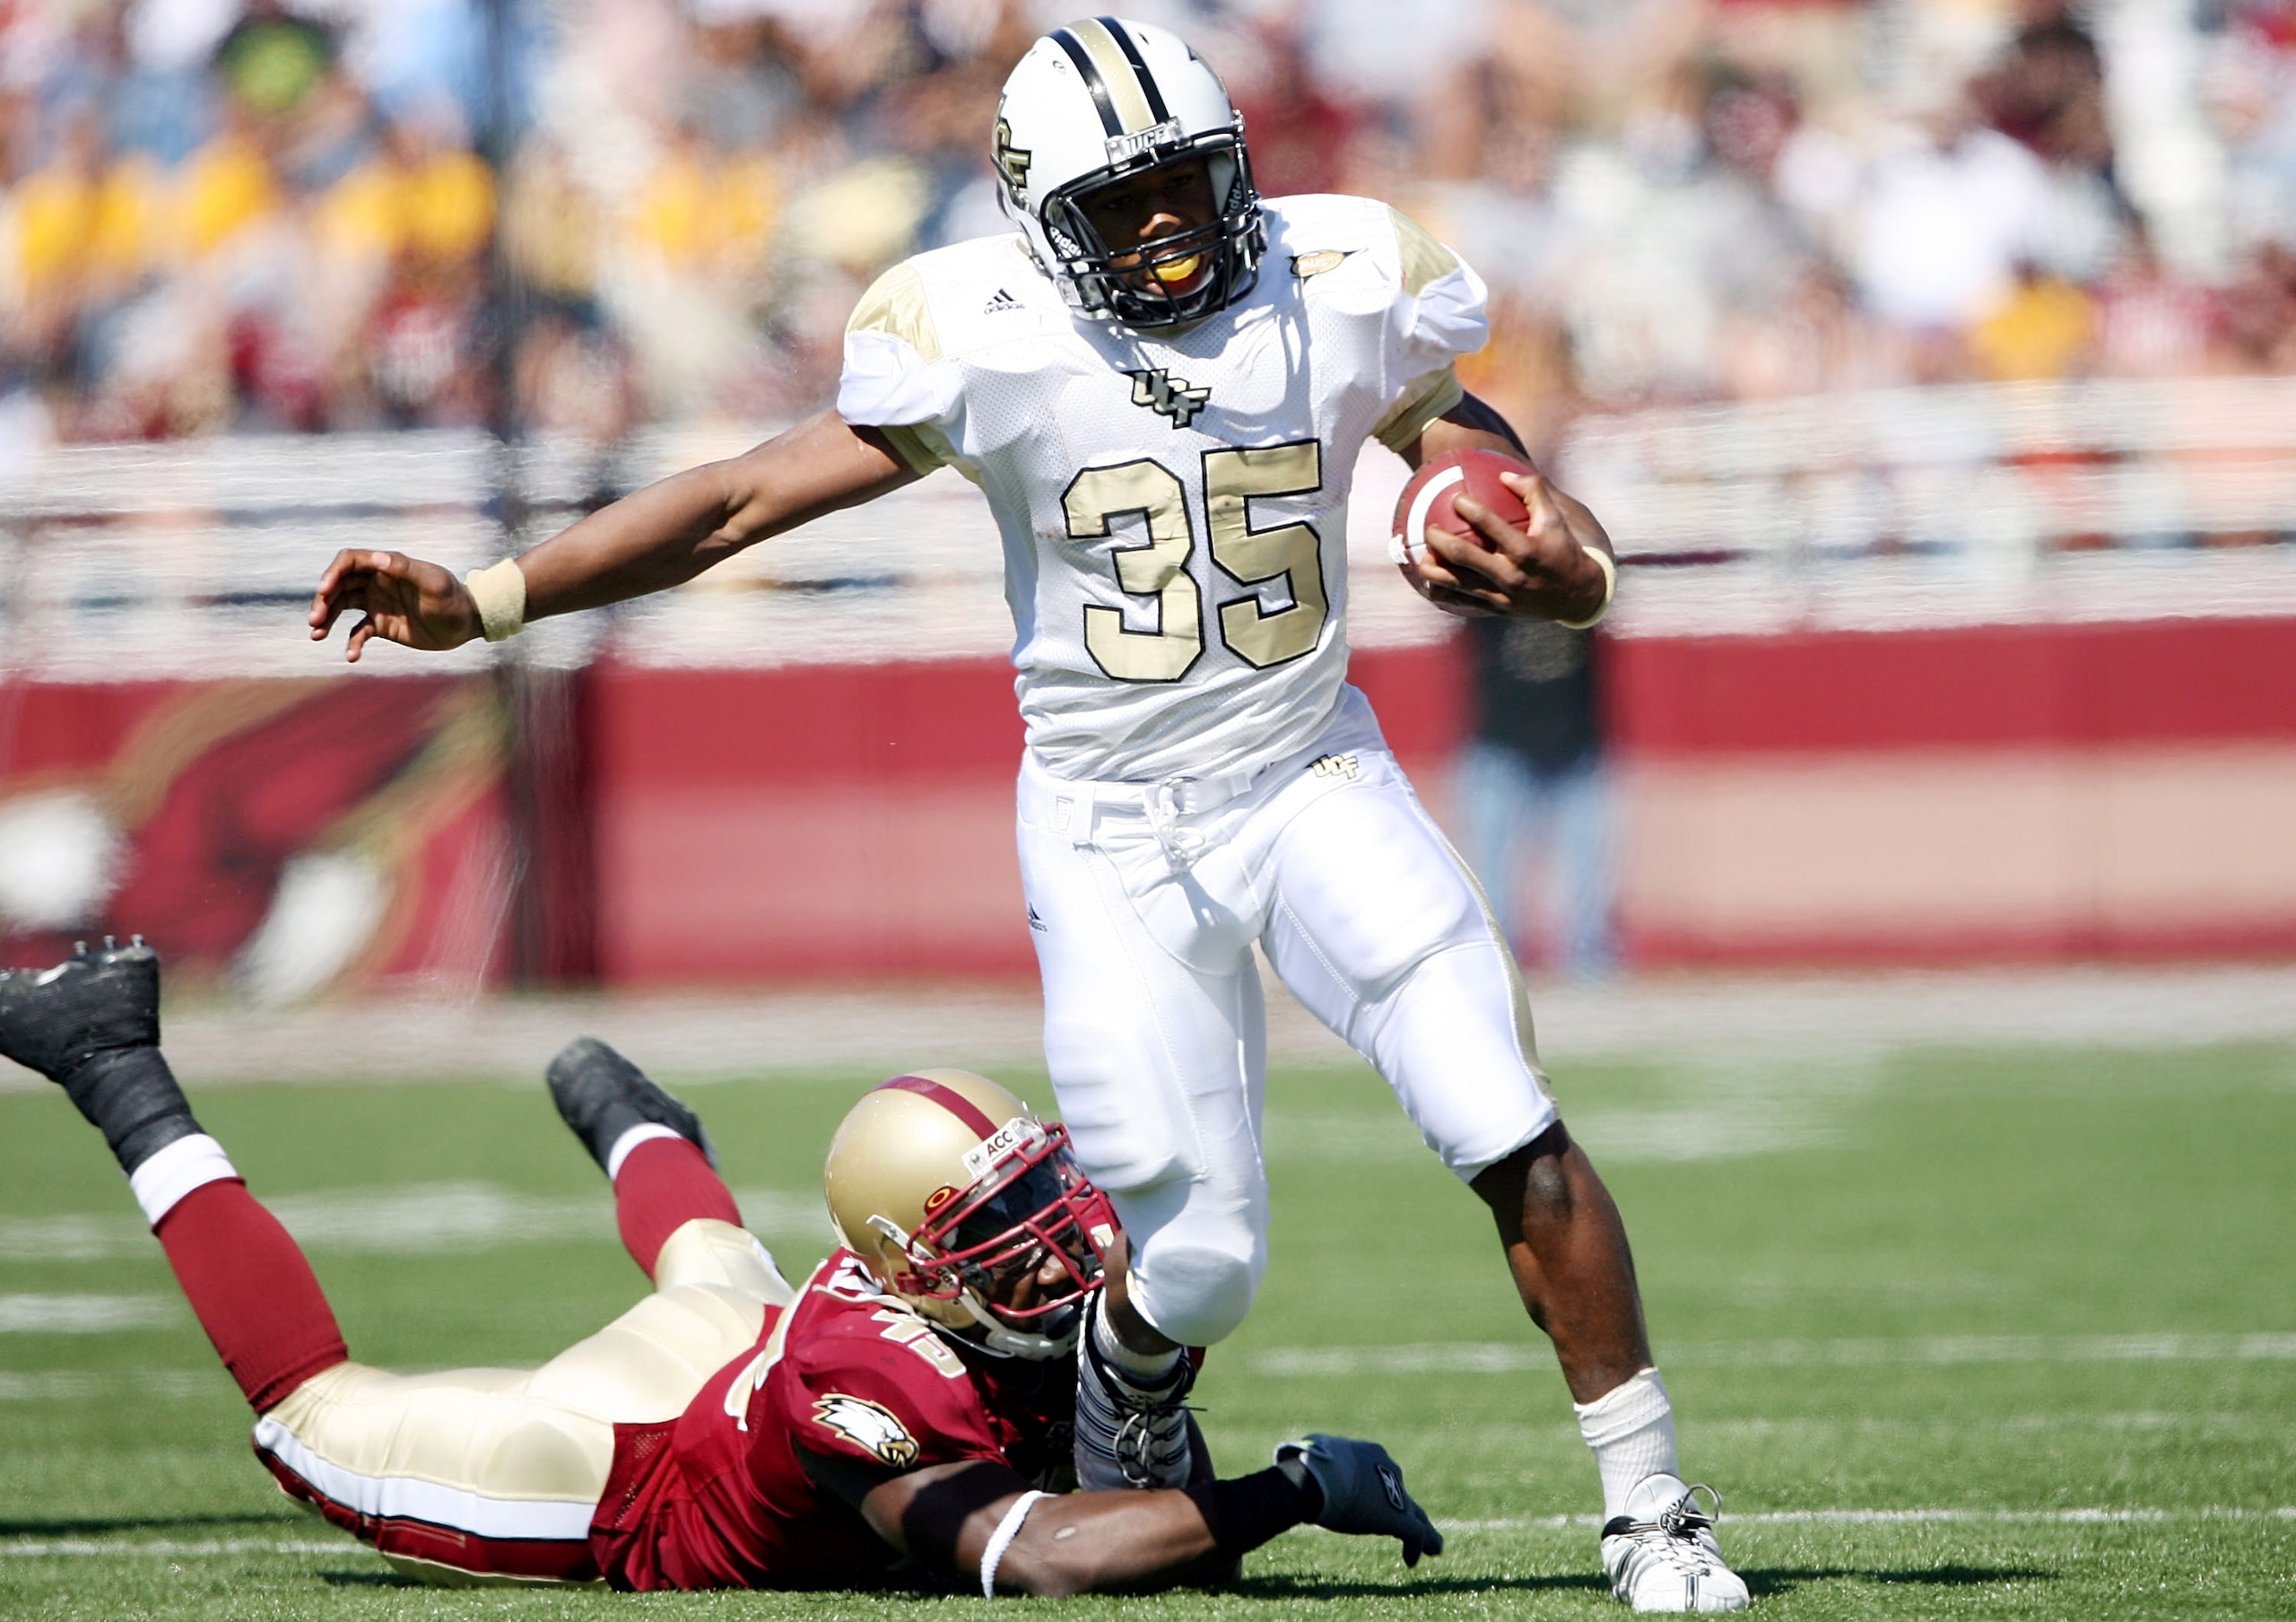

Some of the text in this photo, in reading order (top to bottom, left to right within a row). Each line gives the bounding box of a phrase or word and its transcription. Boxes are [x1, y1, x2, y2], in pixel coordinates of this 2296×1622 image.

[1127, 126, 1166, 156] UCF
[984, 303, 1026, 315] adidas
[1132, 367, 1212, 430] UCF
[1059, 438, 1329, 683] 35
[1311, 754, 1359, 780] UCF
[987, 1129, 1013, 1158] ACC
